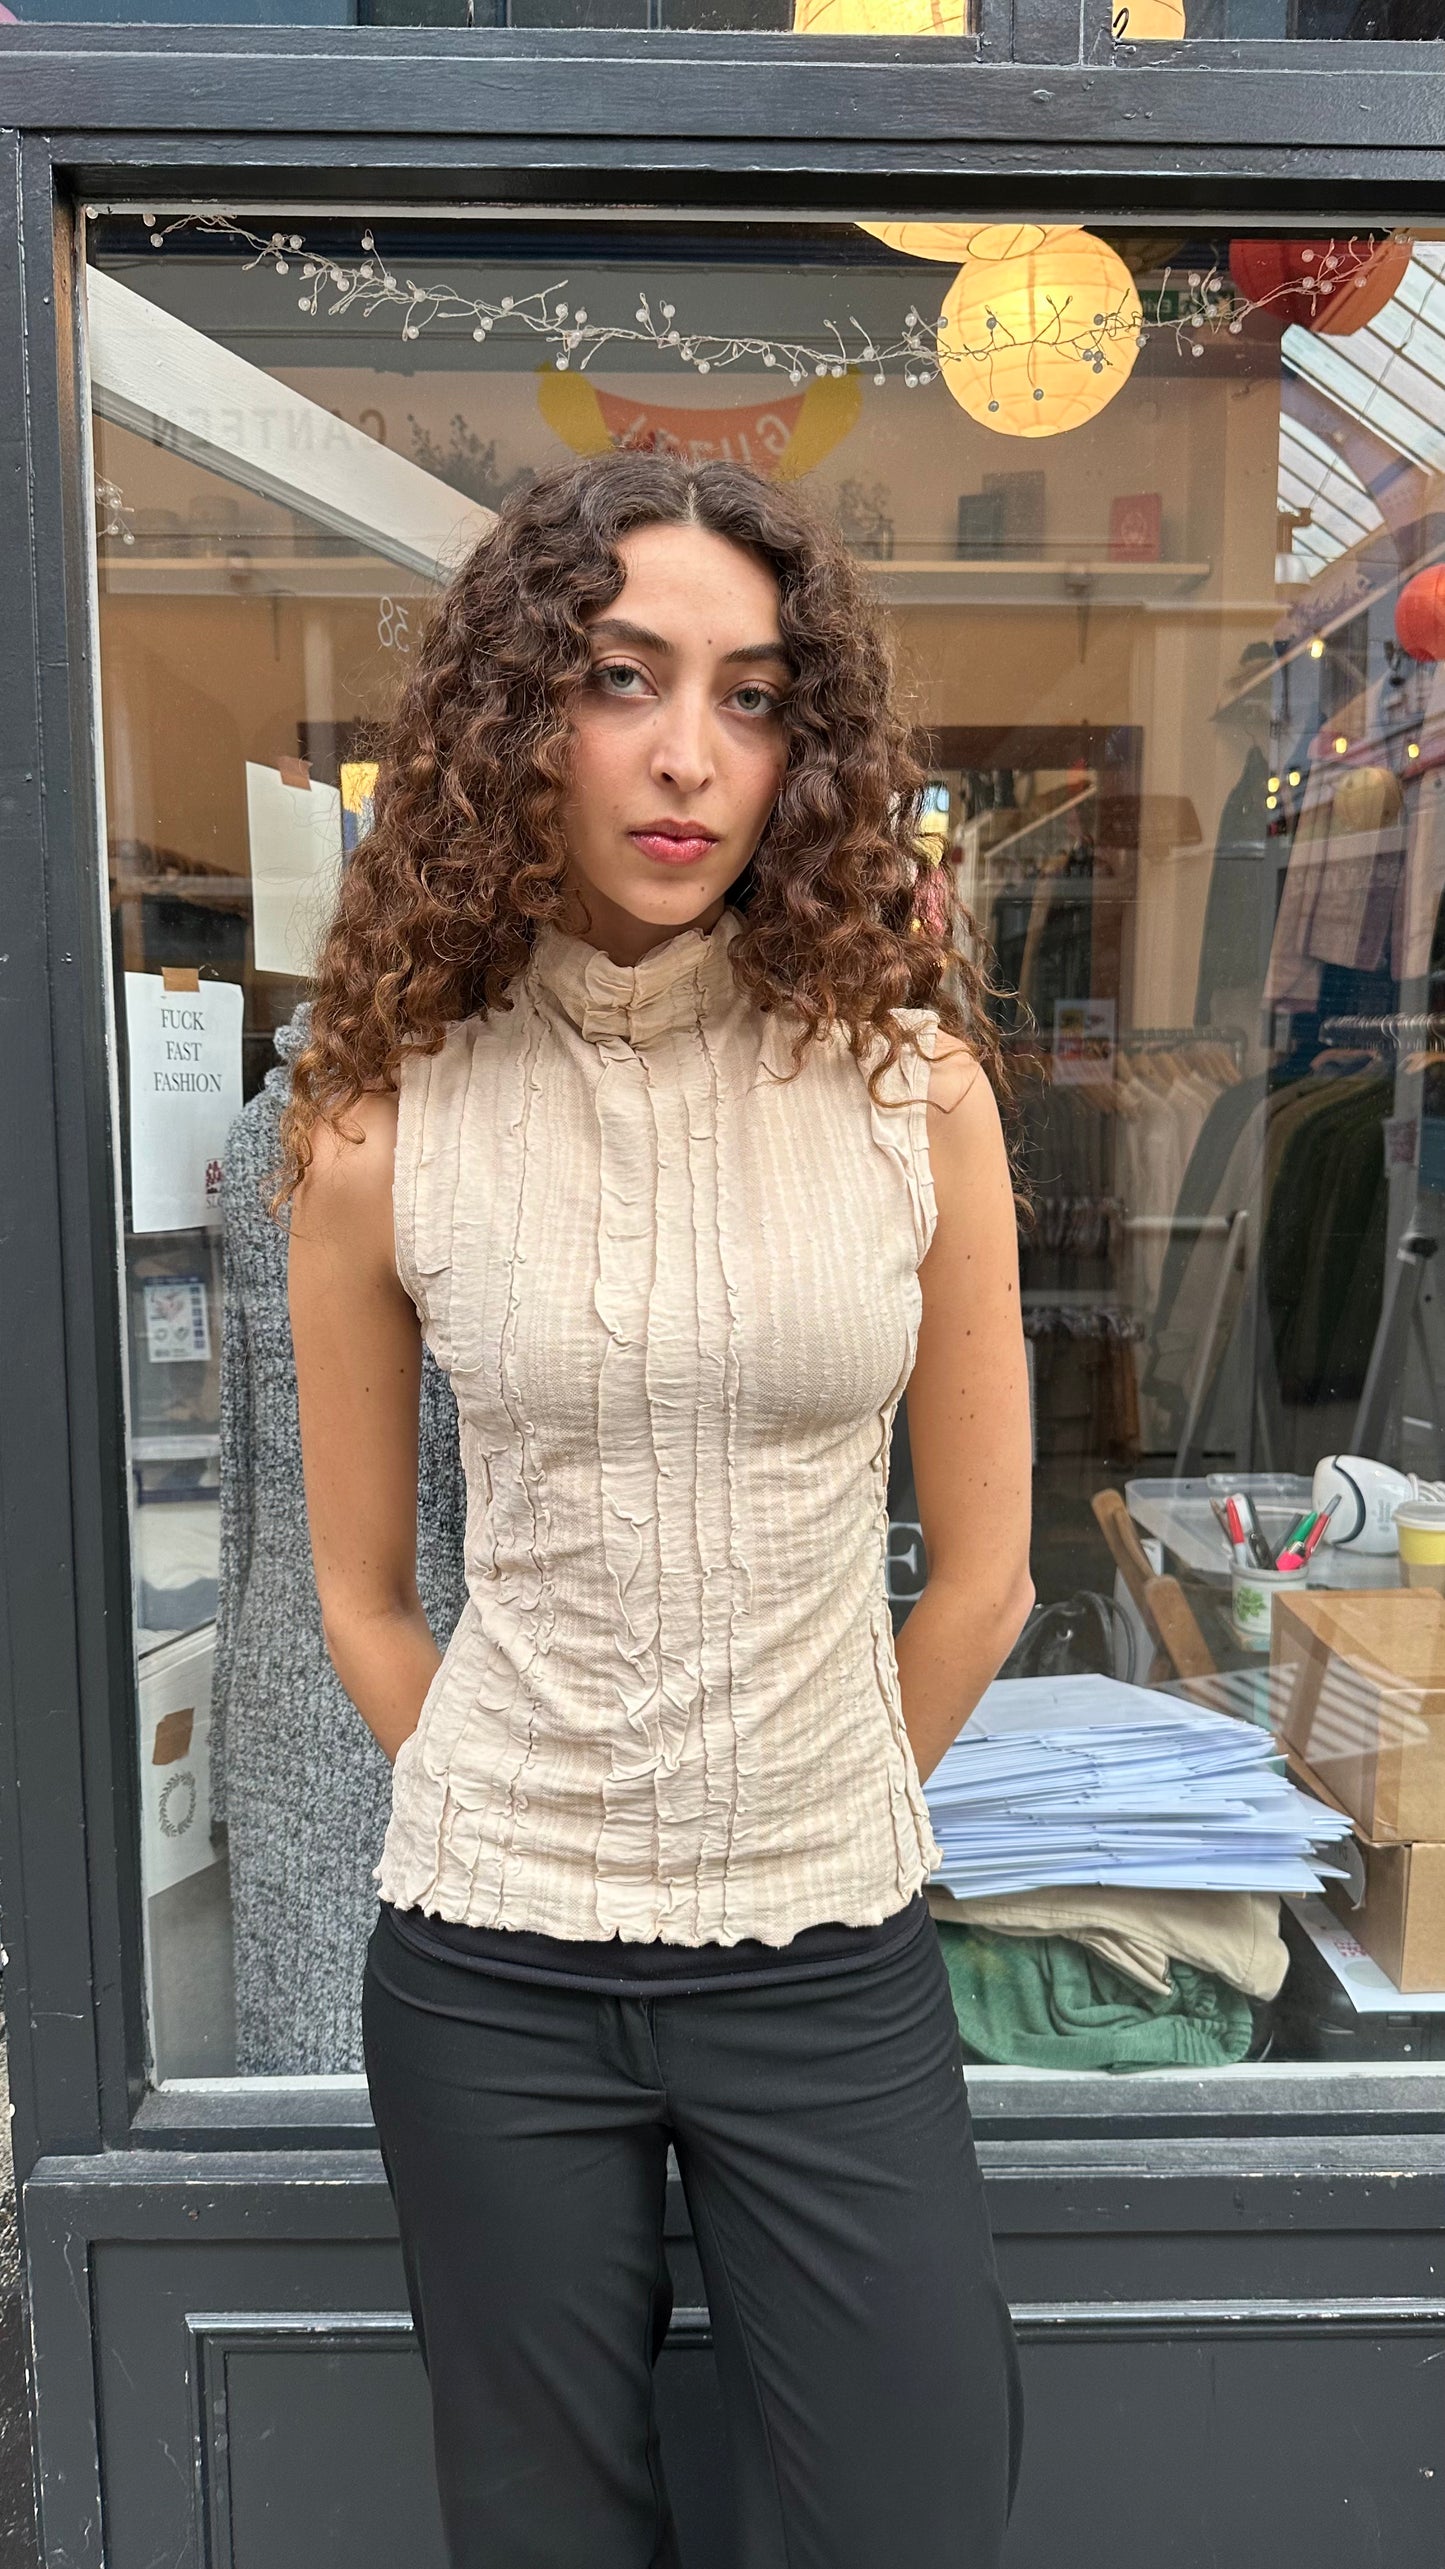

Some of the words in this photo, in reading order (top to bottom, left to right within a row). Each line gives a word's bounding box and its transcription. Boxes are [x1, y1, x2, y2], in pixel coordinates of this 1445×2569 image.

[161, 1008, 205, 1031] FUCK
[166, 1041, 202, 1061] FAST
[154, 1072, 222, 1092] FASHION
